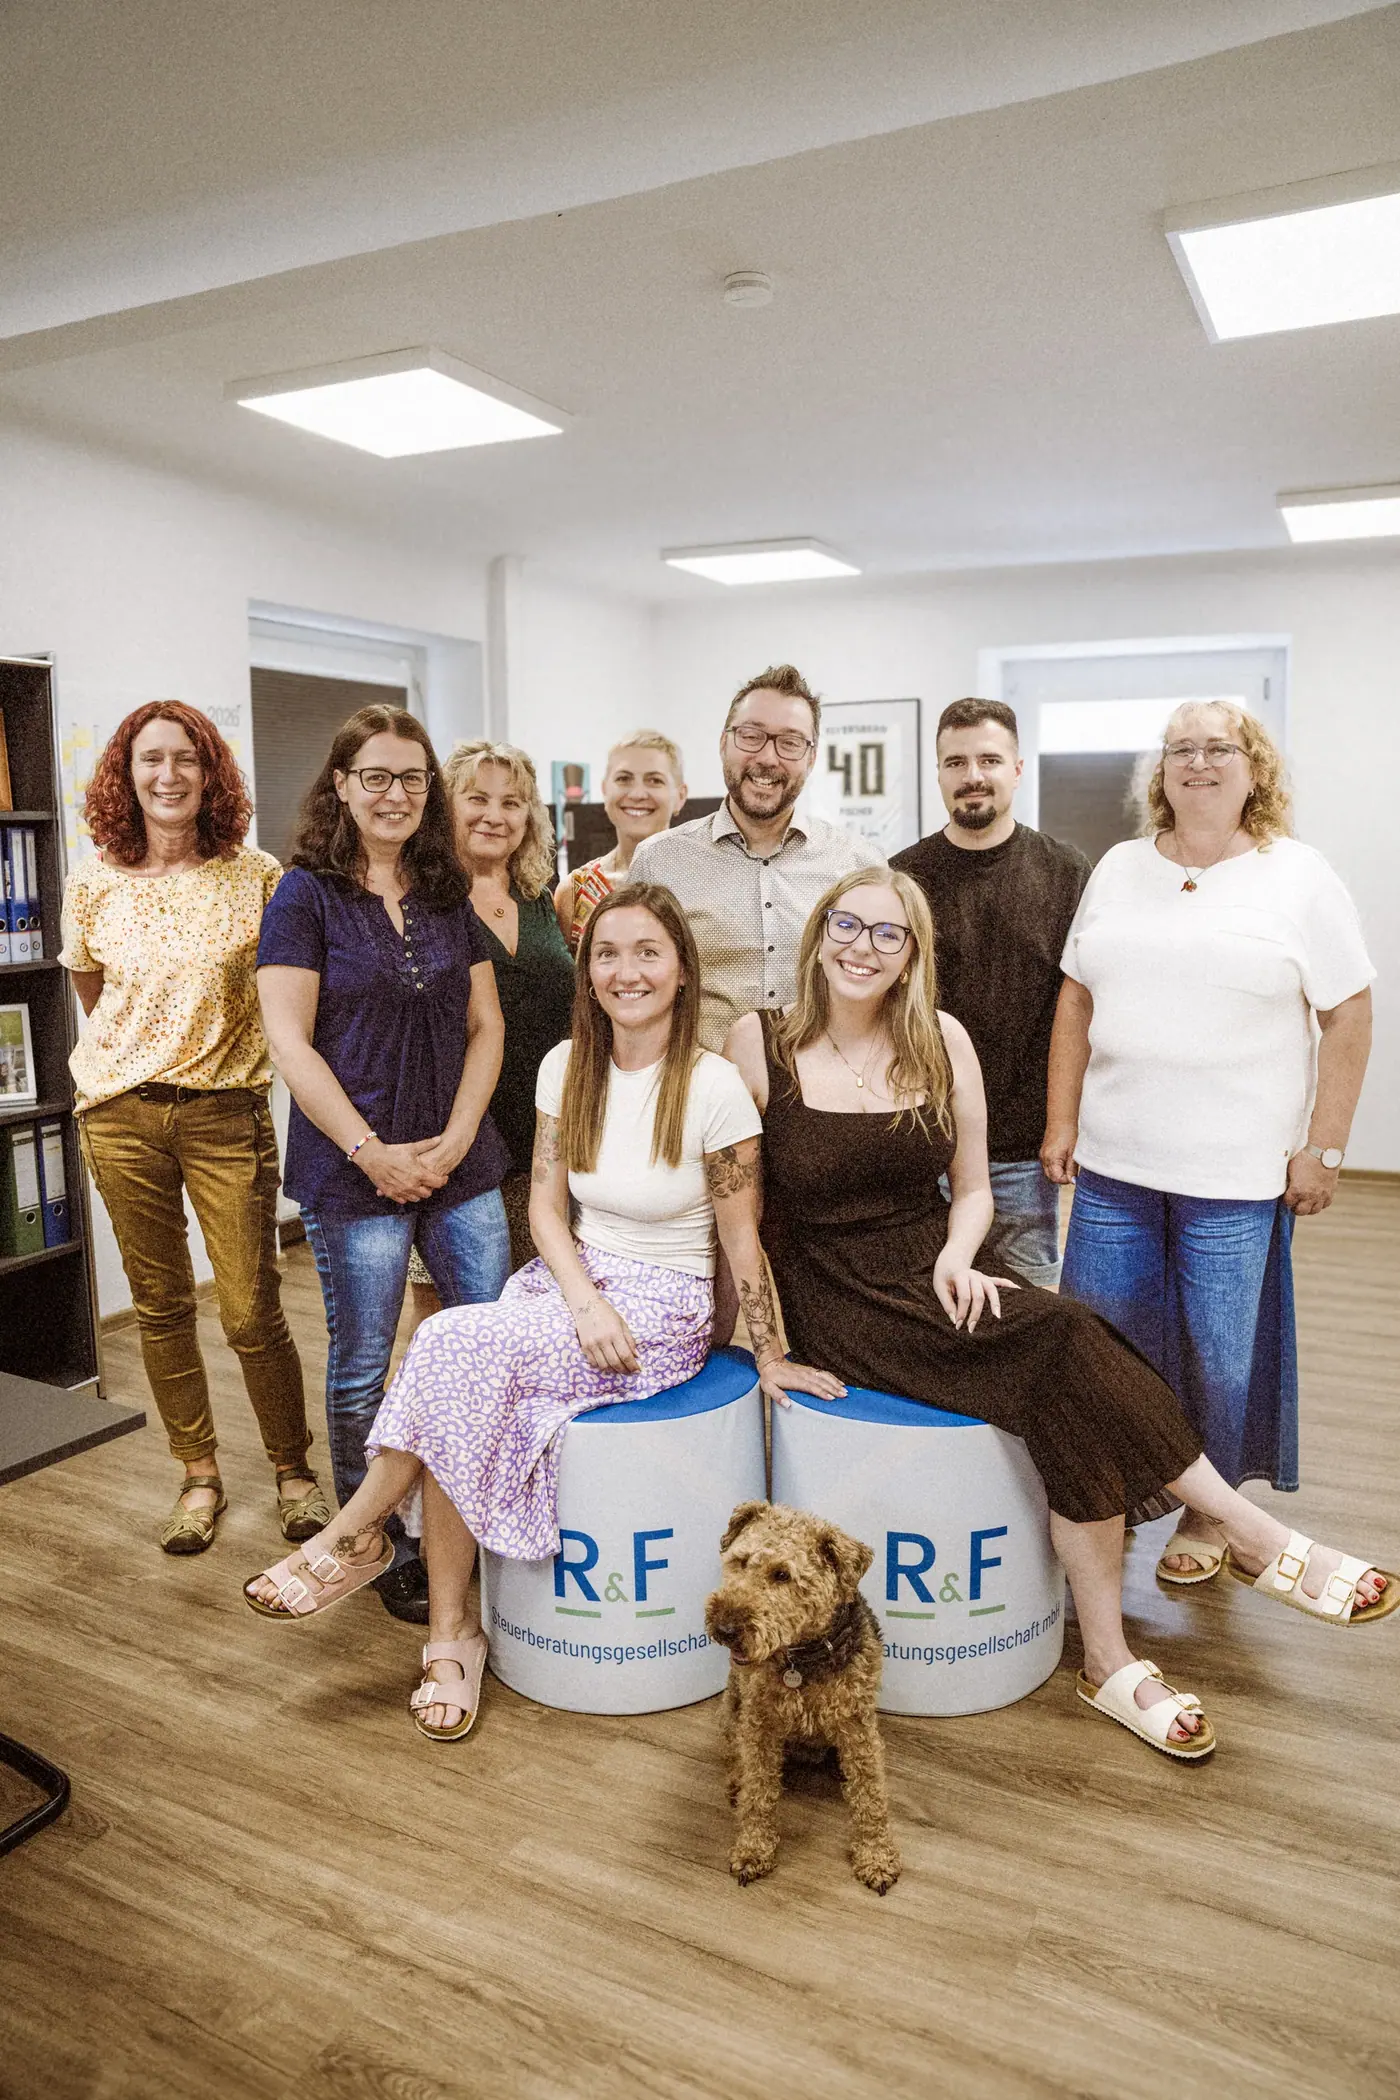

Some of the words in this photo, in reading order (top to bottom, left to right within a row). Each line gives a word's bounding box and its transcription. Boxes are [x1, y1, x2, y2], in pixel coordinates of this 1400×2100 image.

[827, 743, 885, 797] 40
[491, 1605, 711, 1664] Steuerberatungsgesellscha
[881, 1620, 1040, 1665] atungsgesellschaft
[1042, 1600, 1060, 1633] mbH
